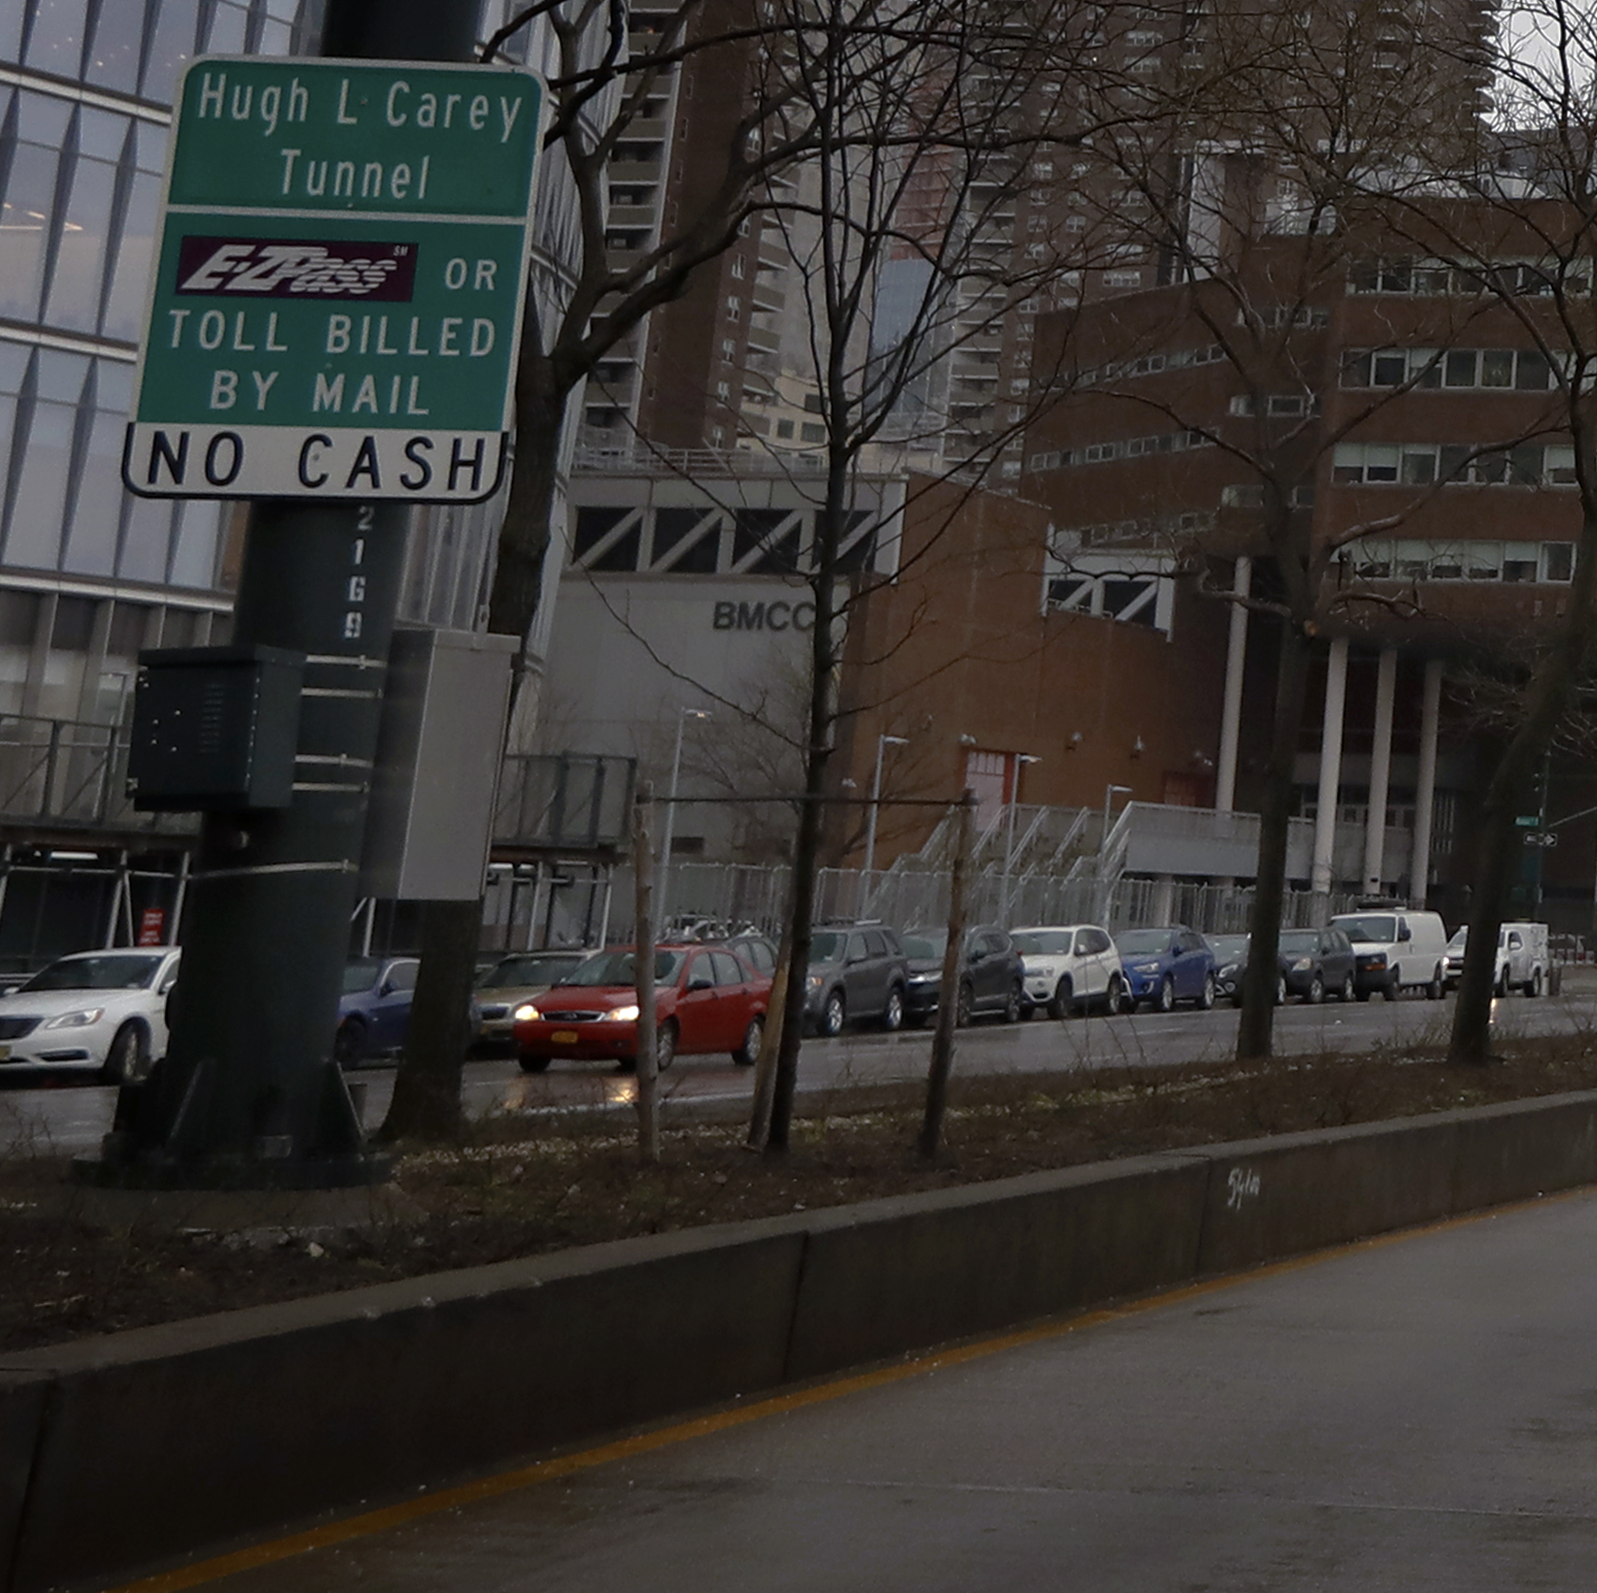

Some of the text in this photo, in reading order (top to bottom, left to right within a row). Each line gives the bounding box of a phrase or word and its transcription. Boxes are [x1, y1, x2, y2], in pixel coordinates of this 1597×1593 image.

[199, 71, 523, 144] Hugh L Carey
[281, 148, 431, 200] Tunnel
[445, 258, 498, 291] OR
[169, 309, 497, 358] TOLL BILLED
[209, 369, 430, 416] BY MAIL
[147, 430, 486, 492] NO CASH
[712, 601, 818, 632] BMCC
